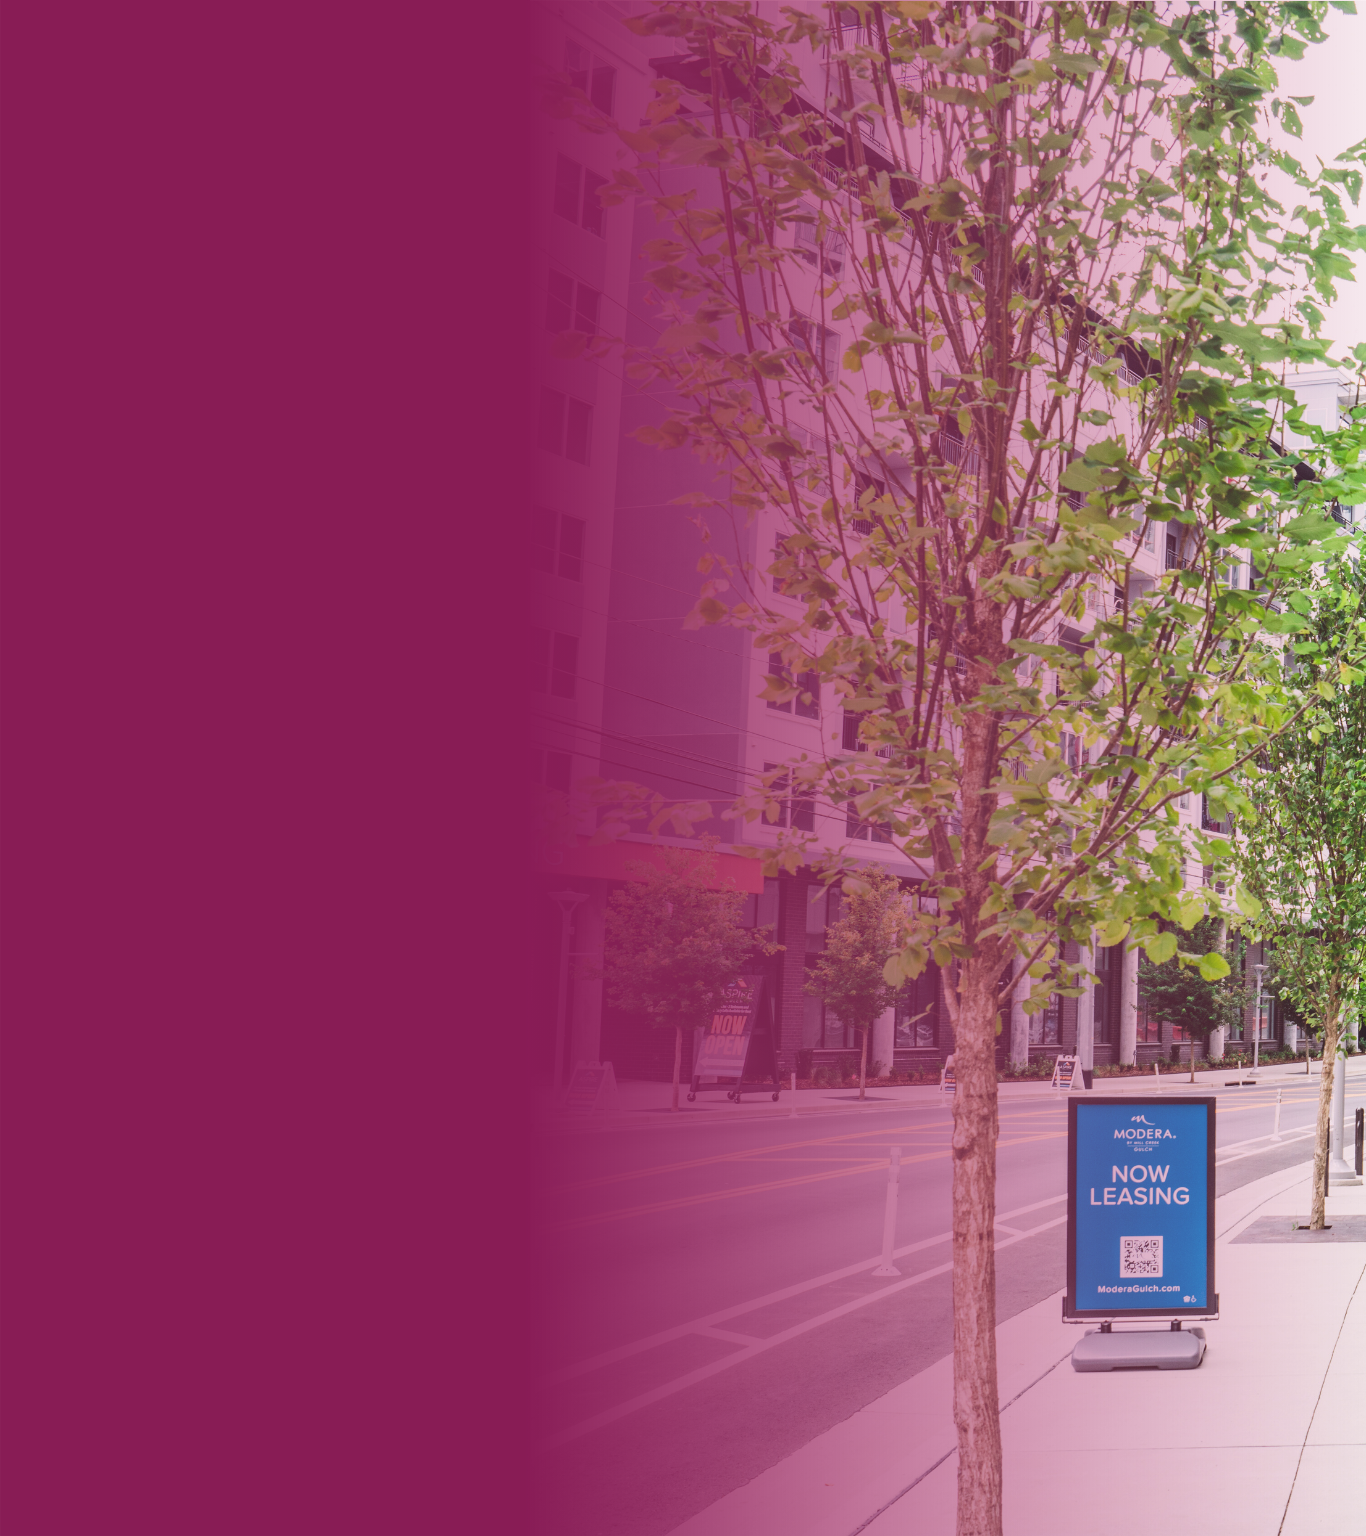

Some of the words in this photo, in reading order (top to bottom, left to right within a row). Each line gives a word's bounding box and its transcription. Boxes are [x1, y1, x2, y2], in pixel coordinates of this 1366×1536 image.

[711, 1014, 747, 1035] NOW
[704, 1035, 745, 1055] OPEN
[1112, 1165, 1170, 1183] NOW
[1090, 1187, 1190, 1205] LEASING
[1097, 1285, 1180, 1293] ModeraGulch.com
